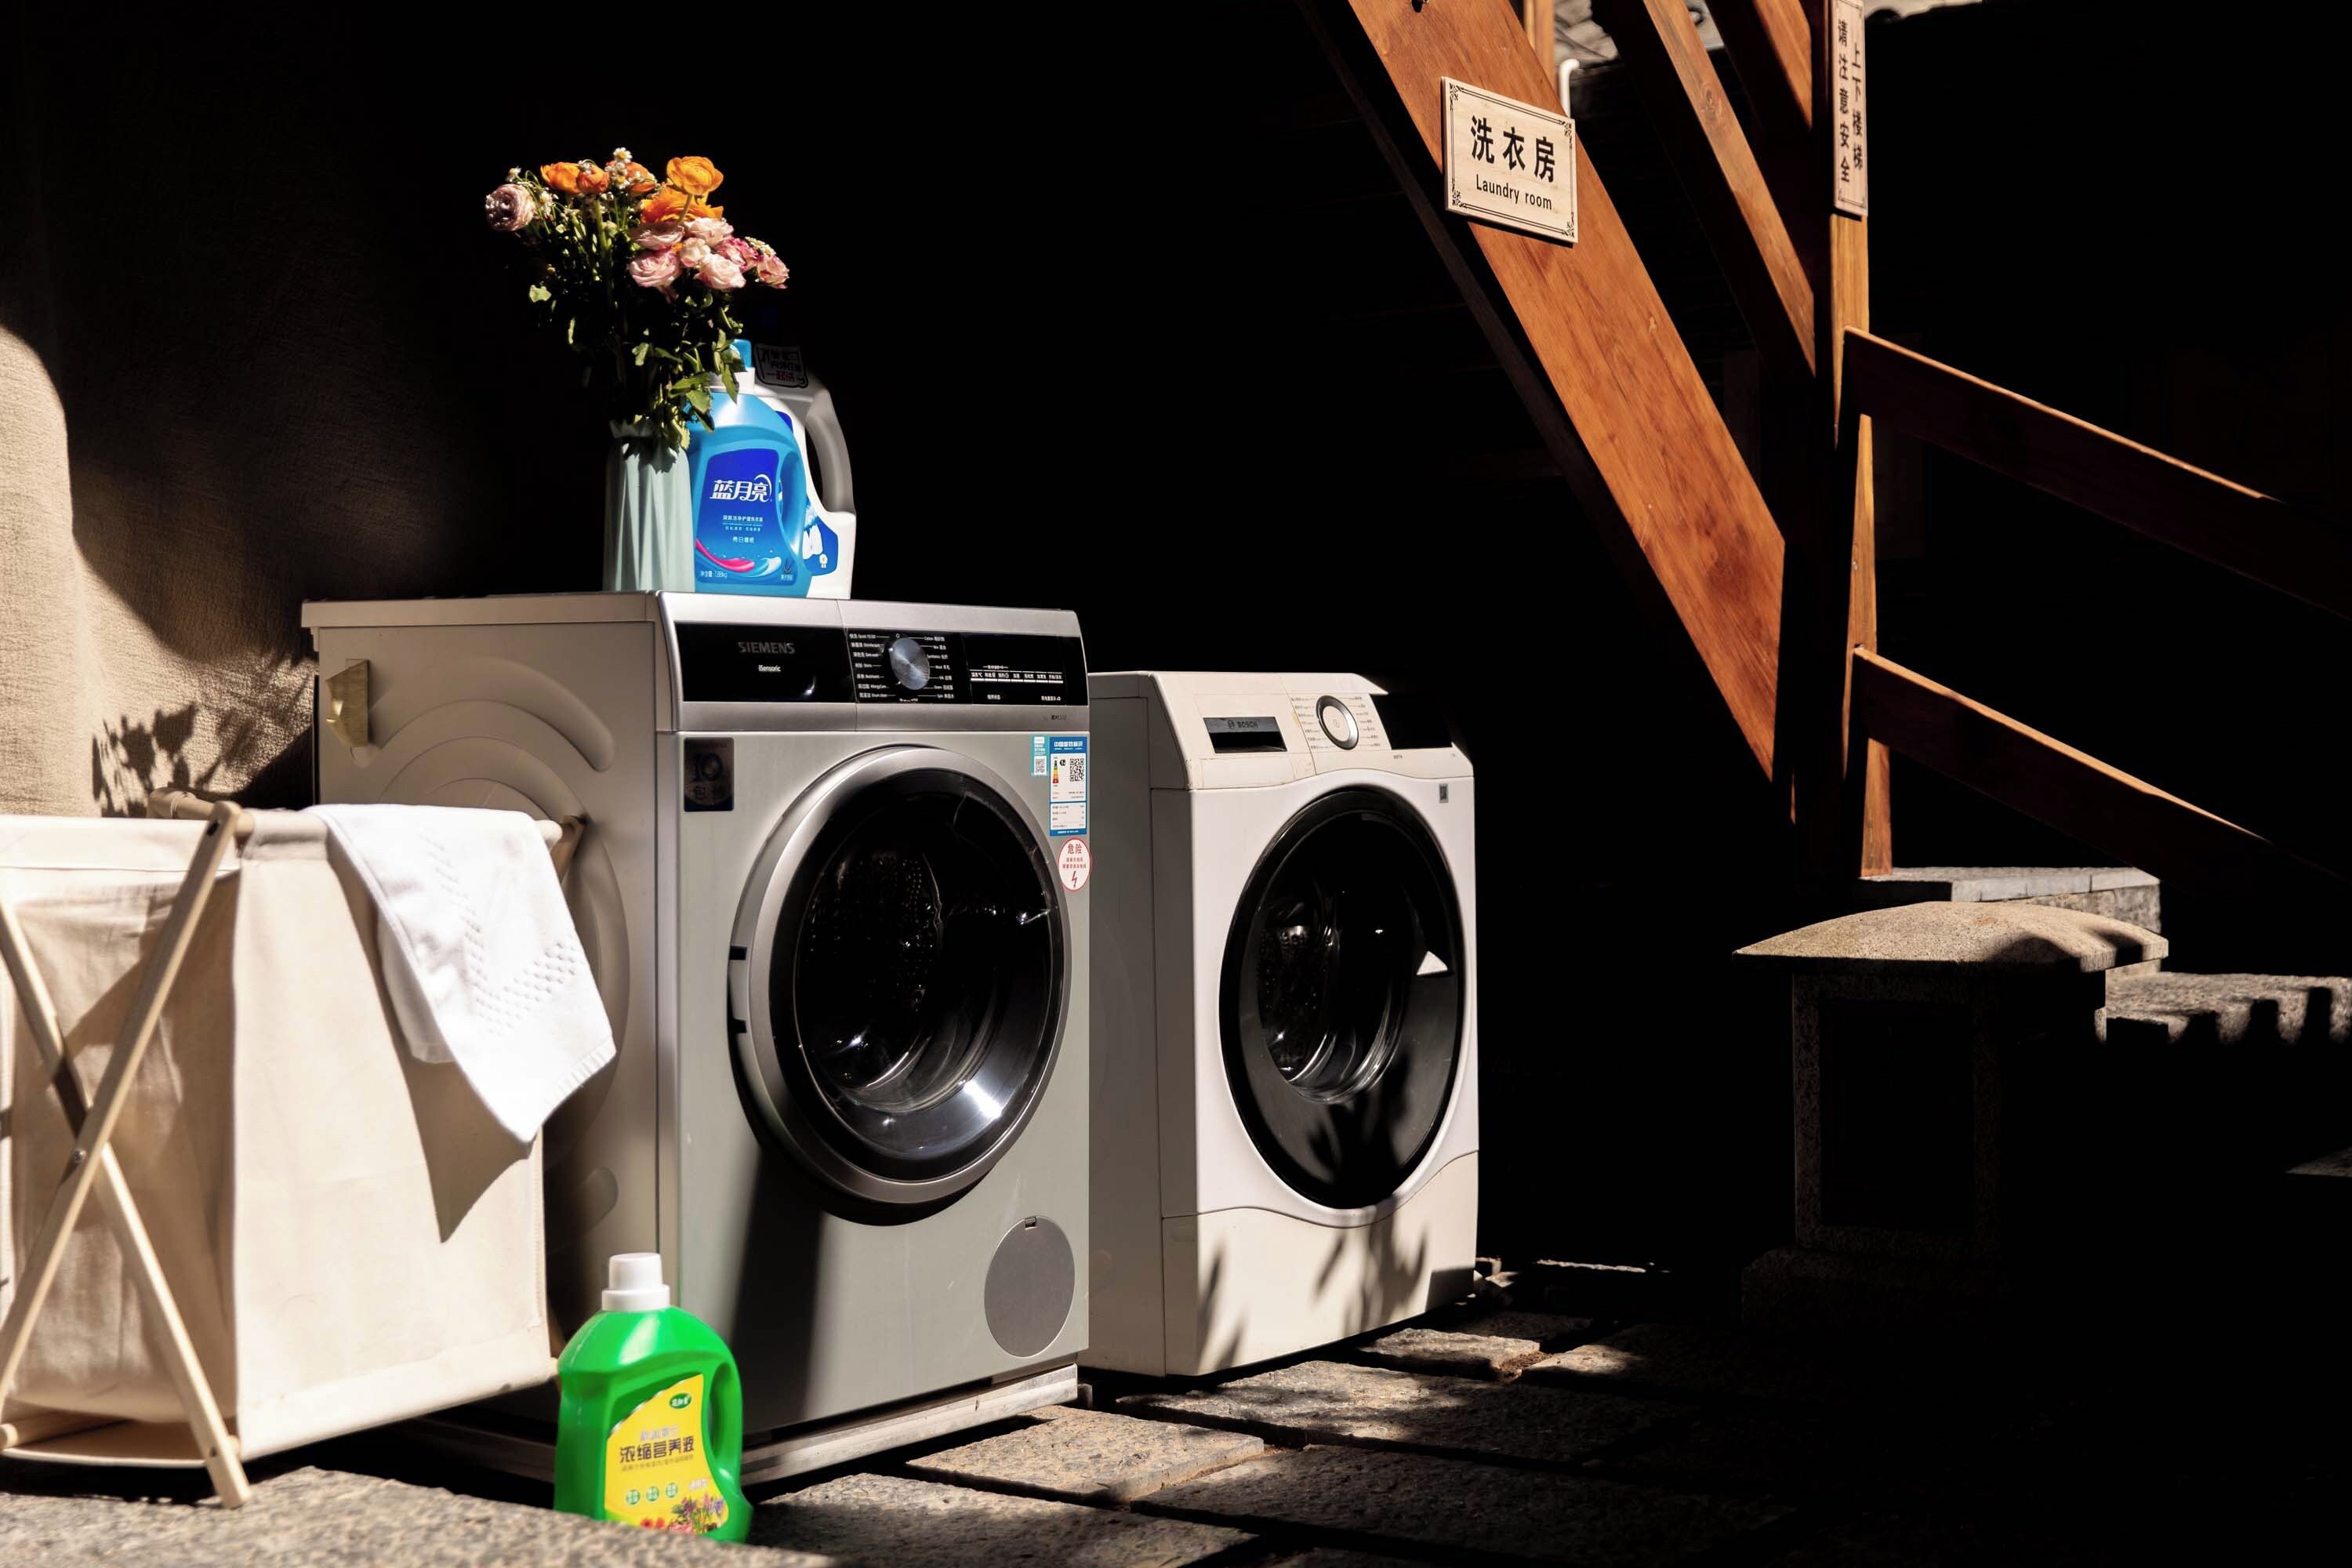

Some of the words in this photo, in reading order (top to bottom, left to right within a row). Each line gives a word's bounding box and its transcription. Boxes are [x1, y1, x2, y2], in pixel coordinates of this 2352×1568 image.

[1838, 20, 1849, 183] 请注意安全
[1852, 42, 1862, 169] 上下楼梯
[1470, 114, 1555, 183] 洗衣房
[1475, 173, 1519, 205] Laundry
[1525, 191, 1552, 211] room
[710, 474, 772, 503] 蓝月亮
[737, 641, 796, 654] SIEMENS
[1068, 844, 1083, 854] 危险
[620, 1436, 694, 1464] 浓缩营养液
